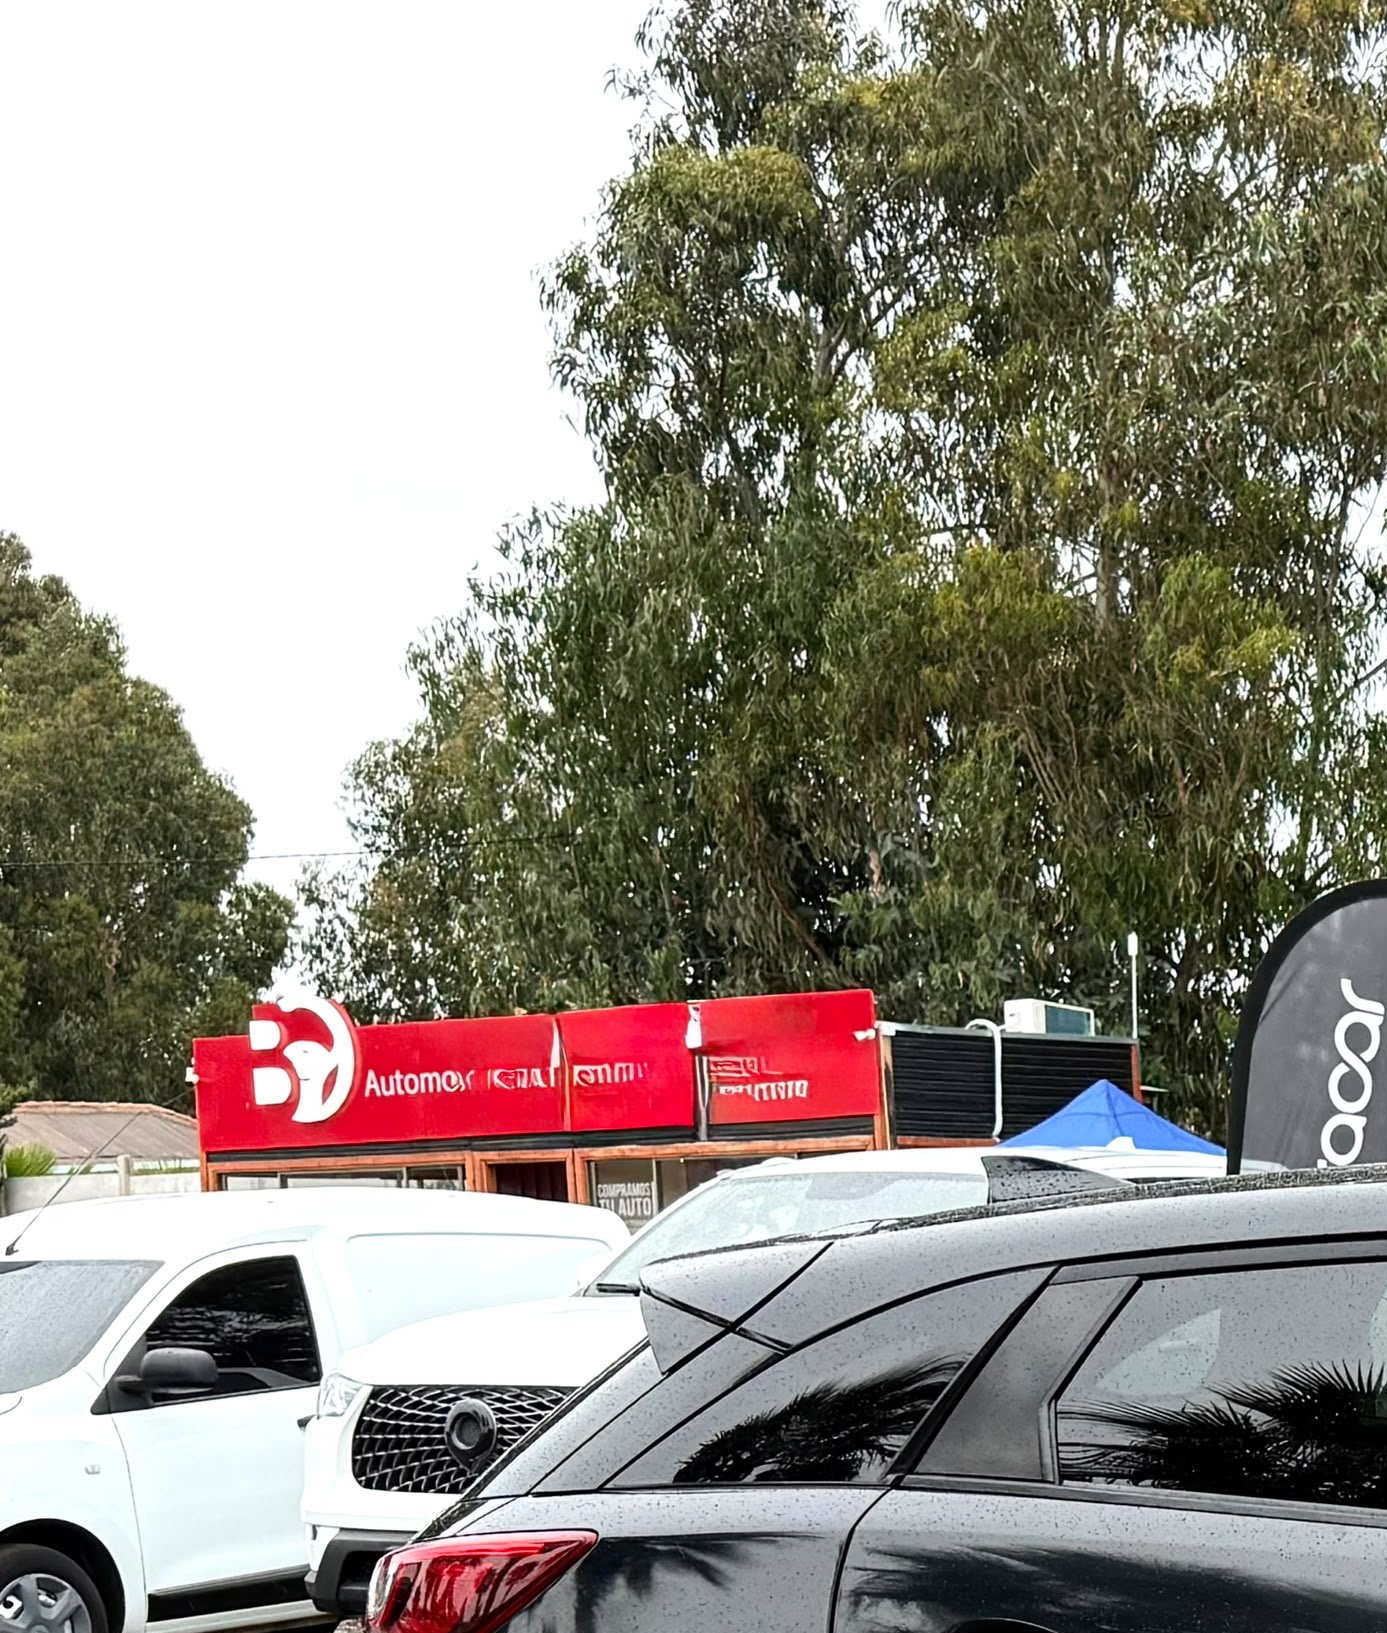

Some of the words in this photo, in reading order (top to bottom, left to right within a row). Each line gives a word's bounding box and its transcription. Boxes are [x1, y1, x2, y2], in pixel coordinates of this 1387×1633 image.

[1317, 978, 1385, 1169] acar
[597, 1182, 651, 1198] COMPRAMOS
[618, 1197, 652, 1217] AUTO
